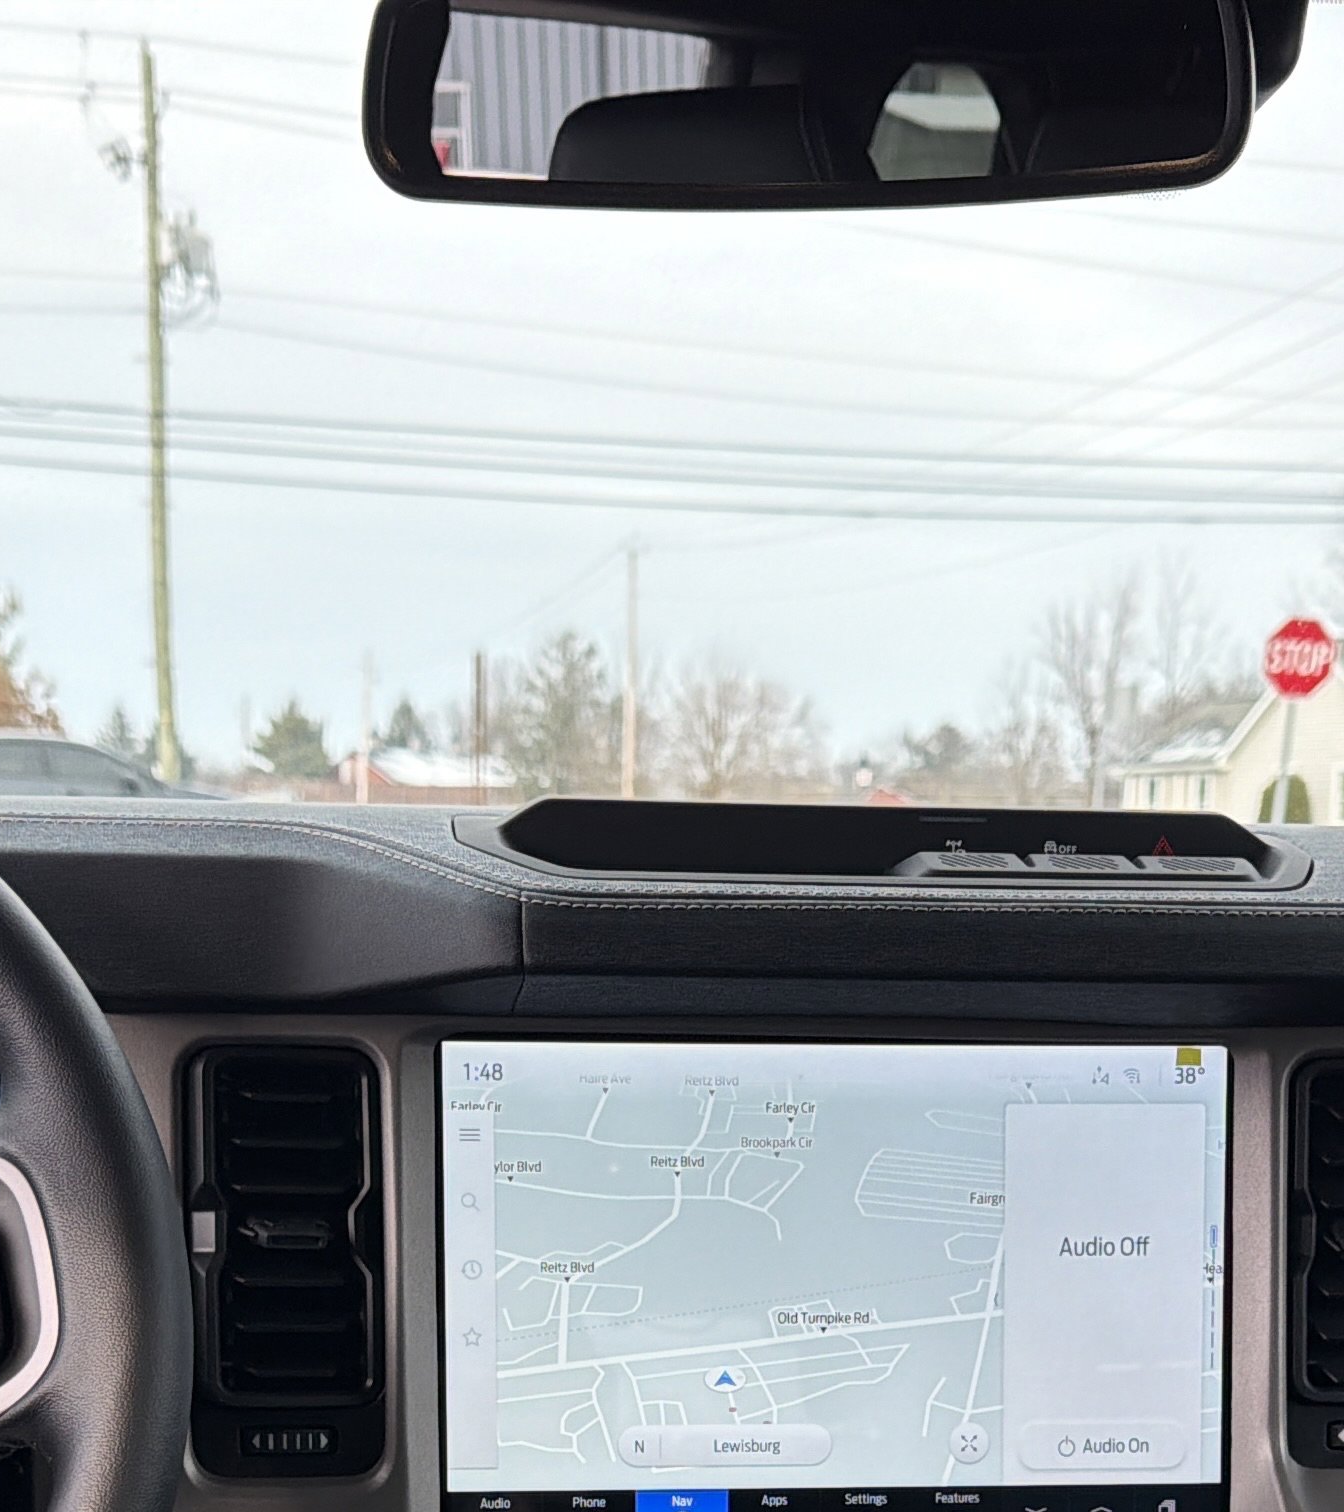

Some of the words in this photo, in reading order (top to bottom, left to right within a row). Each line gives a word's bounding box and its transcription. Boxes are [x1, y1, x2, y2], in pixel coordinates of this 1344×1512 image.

[1269, 639, 1331, 677] STOP
[1058, 845, 1077, 854] OFF
[463, 1062, 504, 1082] 1:48
[610, 1074, 632, 1084] Ave
[684, 1074, 712, 1086] Reitz
[714, 1074, 739, 1087] Blvd
[765, 1101, 799, 1116] Farley
[800, 1102, 815, 1114] Cir
[740, 1136, 798, 1151] Brookpark
[799, 1137, 813, 1149] Cir
[517, 1160, 542, 1173] Blvd
[650, 1155, 678, 1168] Reitz
[680, 1155, 704, 1168] Blvd
[1059, 1236, 1116, 1257] Audio
[1120, 1236, 1150, 1257] Off
[540, 1261, 568, 1274] Reitz
[570, 1261, 595, 1274] Blvd
[777, 1312, 798, 1325] Old
[800, 1311, 852, 1328] Turnpike
[854, 1311, 870, 1325] Rd
[635, 1440, 645, 1453] N
[713, 1438, 781, 1456] Lewisburg
[1082, 1437, 1125, 1455] Audio
[1128, 1437, 1150, 1455] On
[480, 1497, 511, 1510] Audio
[572, 1495, 606, 1509] Phone
[671, 1495, 693, 1507] Nav
[761, 1494, 788, 1508] Apps
[844, 1492, 888, 1507] Settings
[935, 1491, 980, 1505] Features
